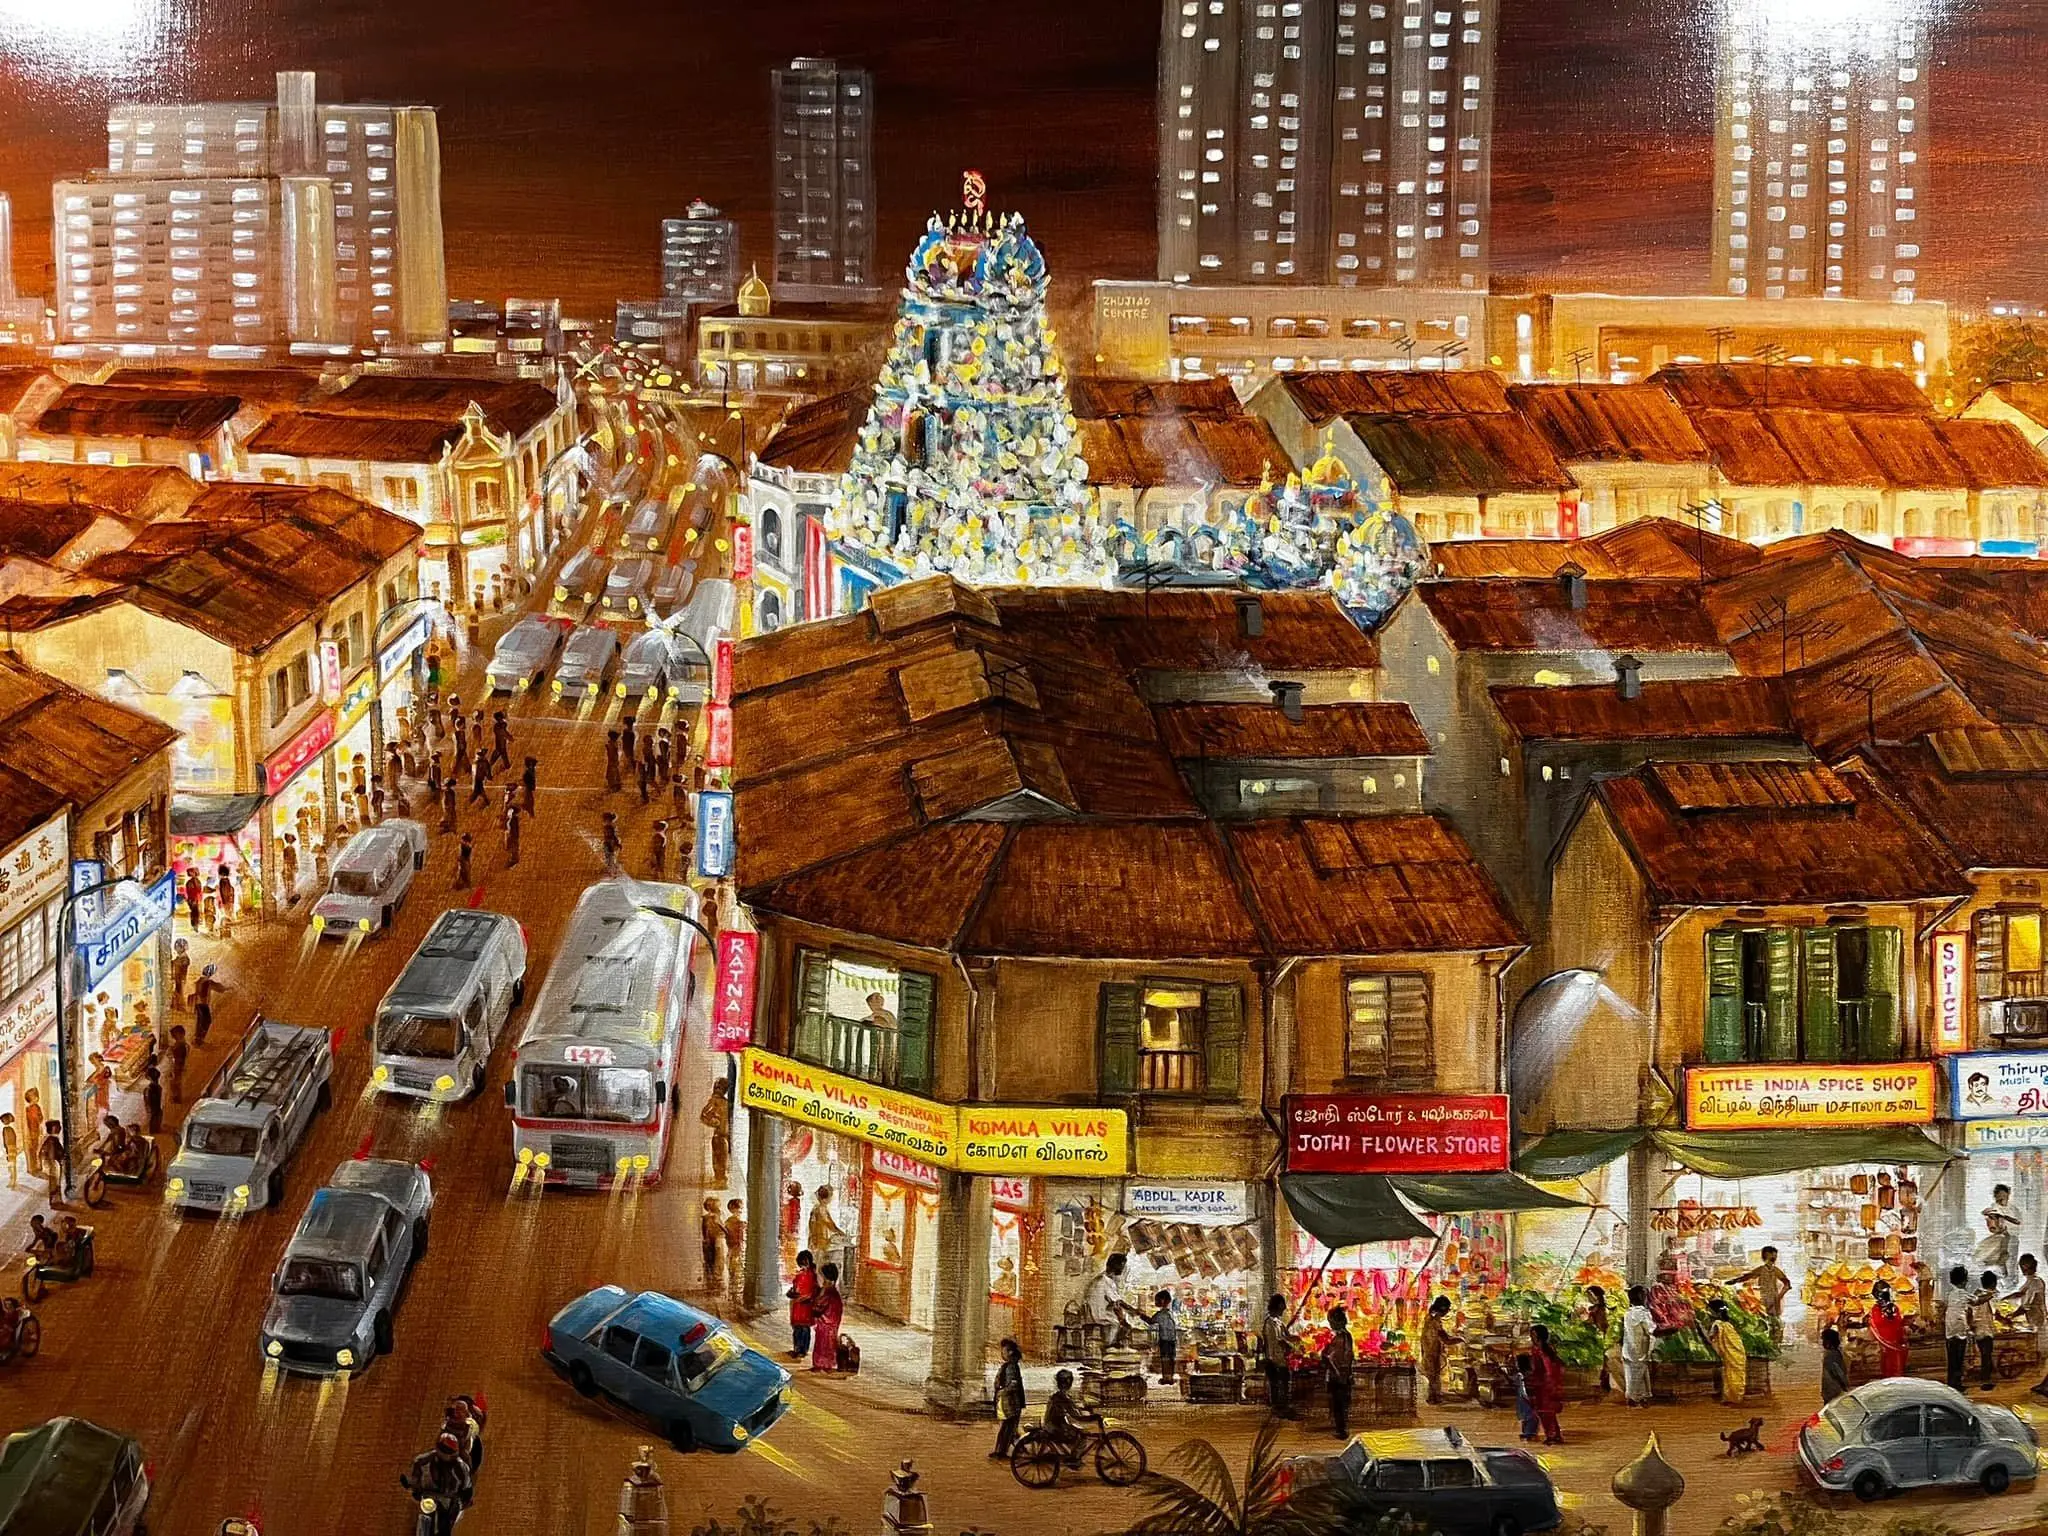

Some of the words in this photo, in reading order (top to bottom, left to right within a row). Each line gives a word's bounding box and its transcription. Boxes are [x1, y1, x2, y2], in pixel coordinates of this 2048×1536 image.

[1103, 296, 1151, 306] ZHUJIAO
[1103, 308, 1149, 319] CENTRE
[725, 938, 745, 1012] RATNA
[1943, 942, 1957, 1031] SPICE
[717, 1021, 750, 1039] Sari
[752, 1060, 814, 1092] KOMALA
[822, 1083, 868, 1109] VILAS
[1700, 1079, 1753, 1092] LITTLE
[1765, 1078, 1810, 1091] INDIA
[1818, 1077, 1864, 1091] SPICE
[1872, 1076, 1918, 1091] SHOP
[2000, 1075, 2031, 1086] Music
[880, 1099, 943, 1125] VEGETARIAN
[1700, 1095, 1752, 1118] லிட்டில்
[1757, 1094, 1818, 1118] இந்தியா
[748, 1082, 797, 1108] கோமள
[802, 1100, 861, 1128] விலாஸ்
[866, 1122, 948, 1157] உணவகம்
[968, 1119, 1040, 1138] KOMALA
[1050, 1121, 1108, 1138] VILAS
[965, 1142, 1028, 1158] கோமள
[1036, 1141, 1108, 1161] விலாஸ்
[1297, 1134, 1351, 1152] JOTHI
[1362, 1136, 1439, 1154] FLOWER
[1444, 1135, 1501, 1154] STORE
[1133, 1189, 1177, 1202] ABDUL
[1185, 1189, 1226, 1203] KADIR
